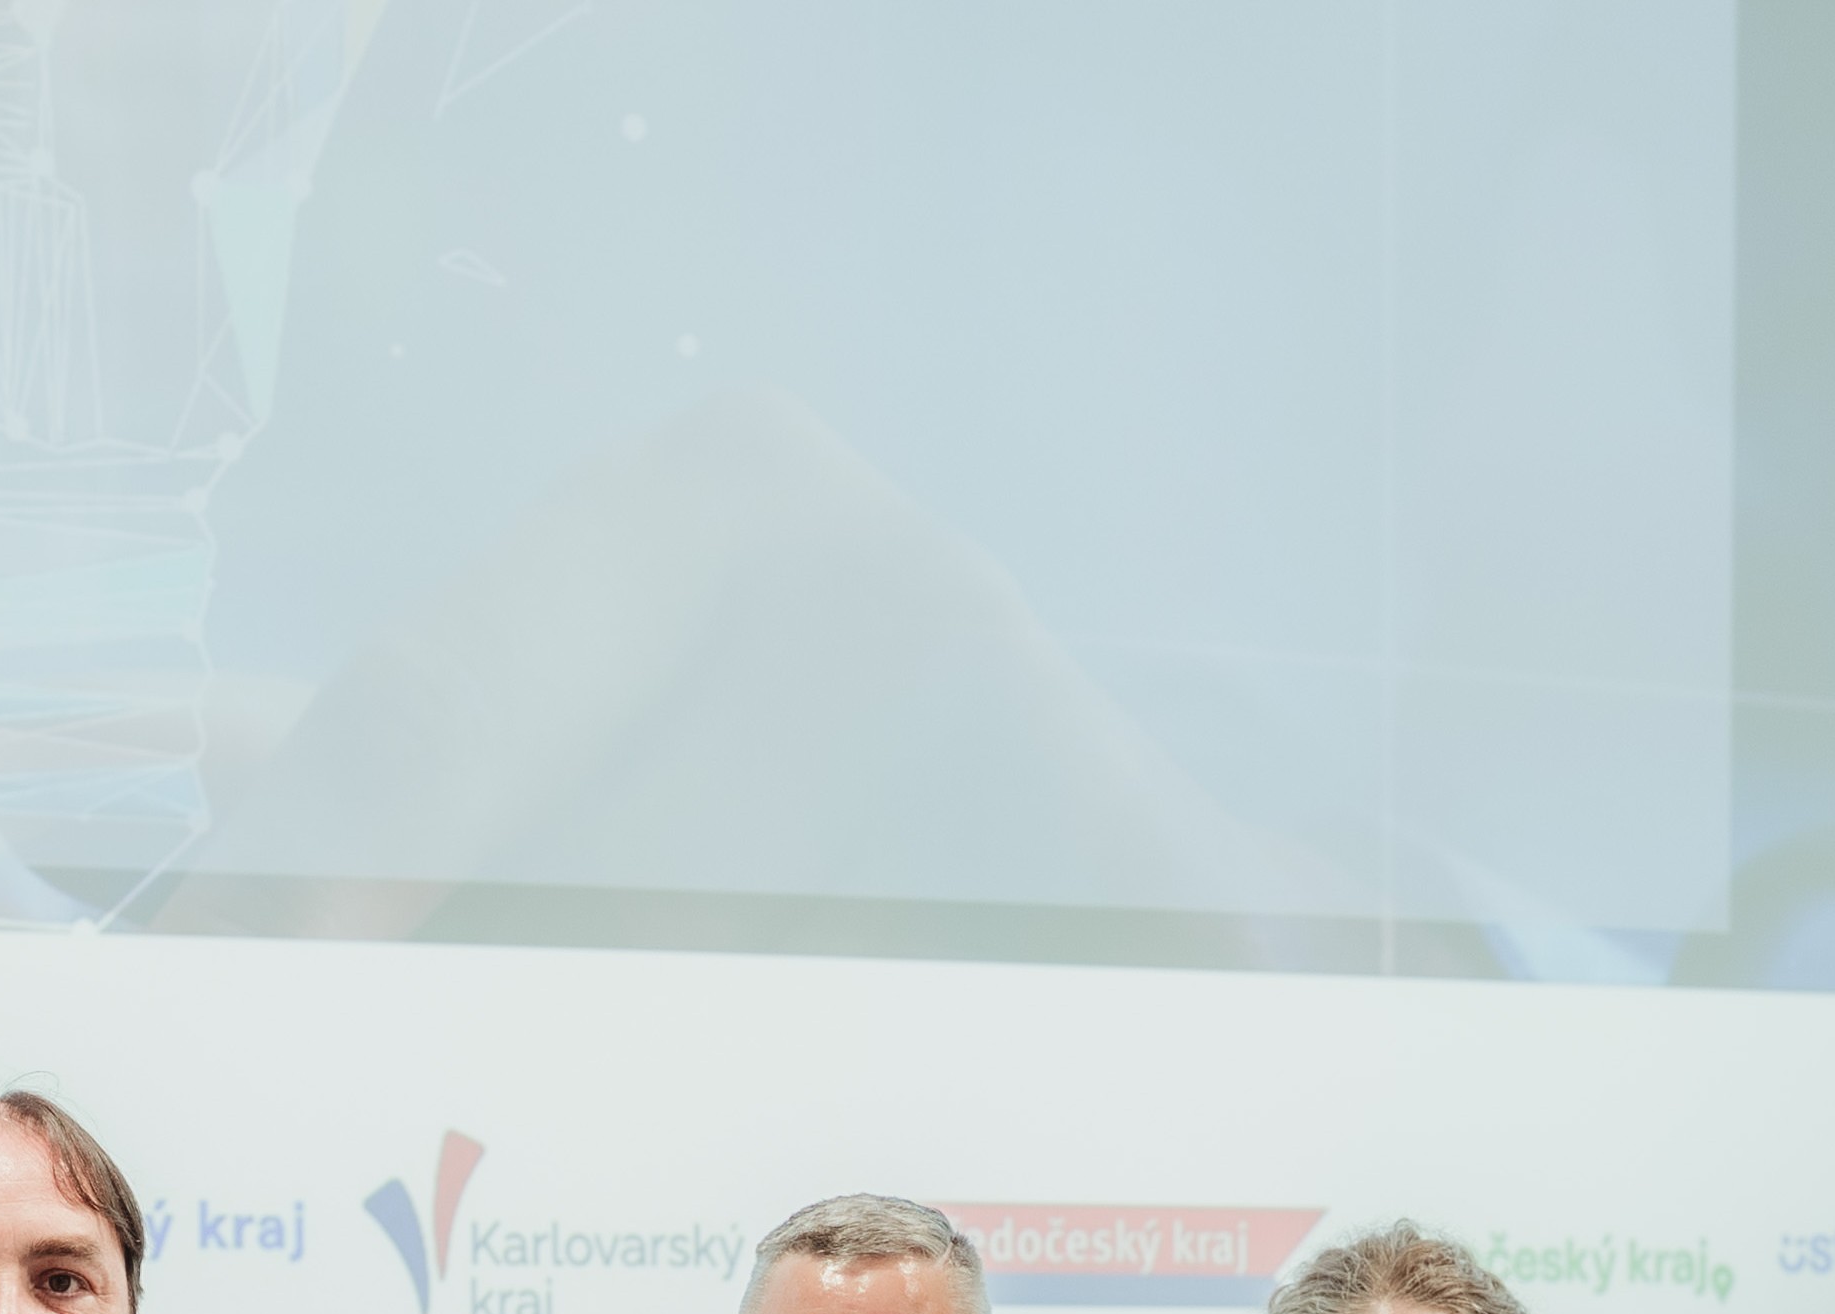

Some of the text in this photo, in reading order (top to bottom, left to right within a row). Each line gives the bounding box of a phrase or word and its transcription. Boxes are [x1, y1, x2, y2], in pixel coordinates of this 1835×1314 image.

[198, 1200, 305, 1261] kraj
[469, 1220, 746, 1281] Karlovarský
[954, 1216, 1251, 1277] edočeský kraj
[1482, 1231, 1710, 1295] český kraj
